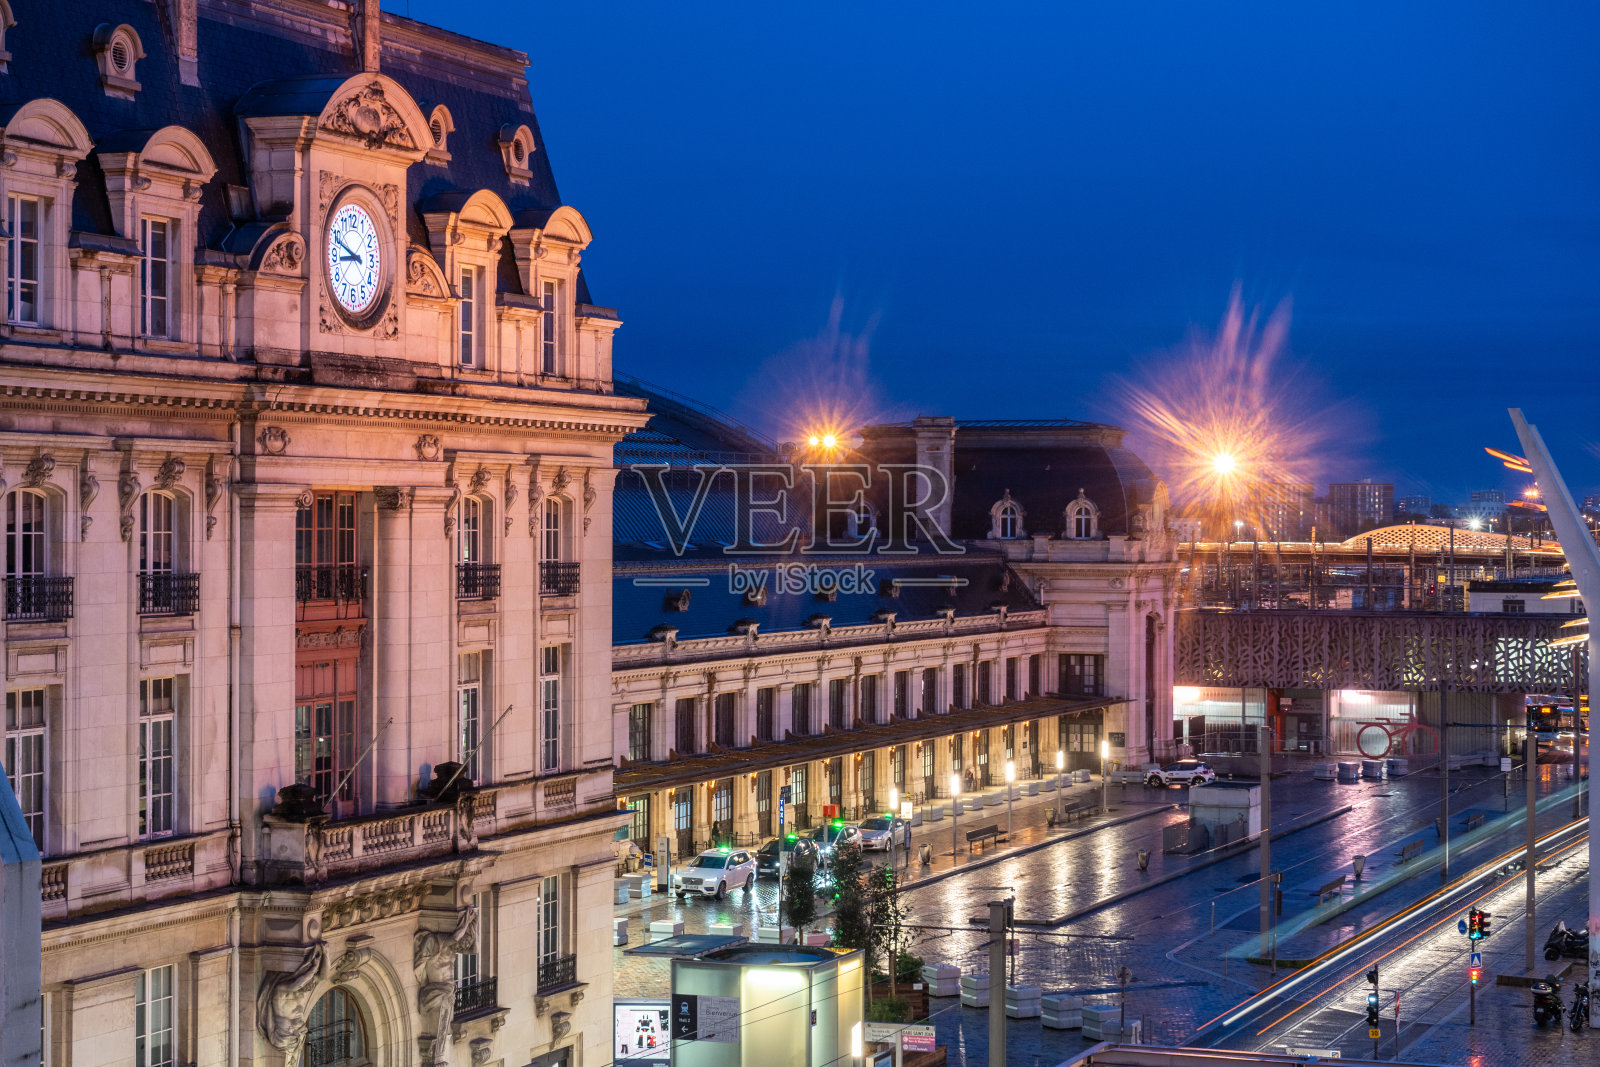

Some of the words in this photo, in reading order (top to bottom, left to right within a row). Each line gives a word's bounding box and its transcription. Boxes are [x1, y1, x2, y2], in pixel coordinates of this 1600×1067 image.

[341, 217, 347, 232] 11
[349, 213, 357, 228] 12
[361, 219, 364, 234] 1
[333, 229, 341, 244] 10
[367, 234, 372, 248] 2
[332, 247, 337, 263] 9
[369, 254, 374, 268] 3
[335, 267, 340, 282] 8
[367, 272, 372, 286] 4
[342, 283, 347, 296] 7
[351, 288, 356, 303] 6
[361, 285, 366, 299] 5
